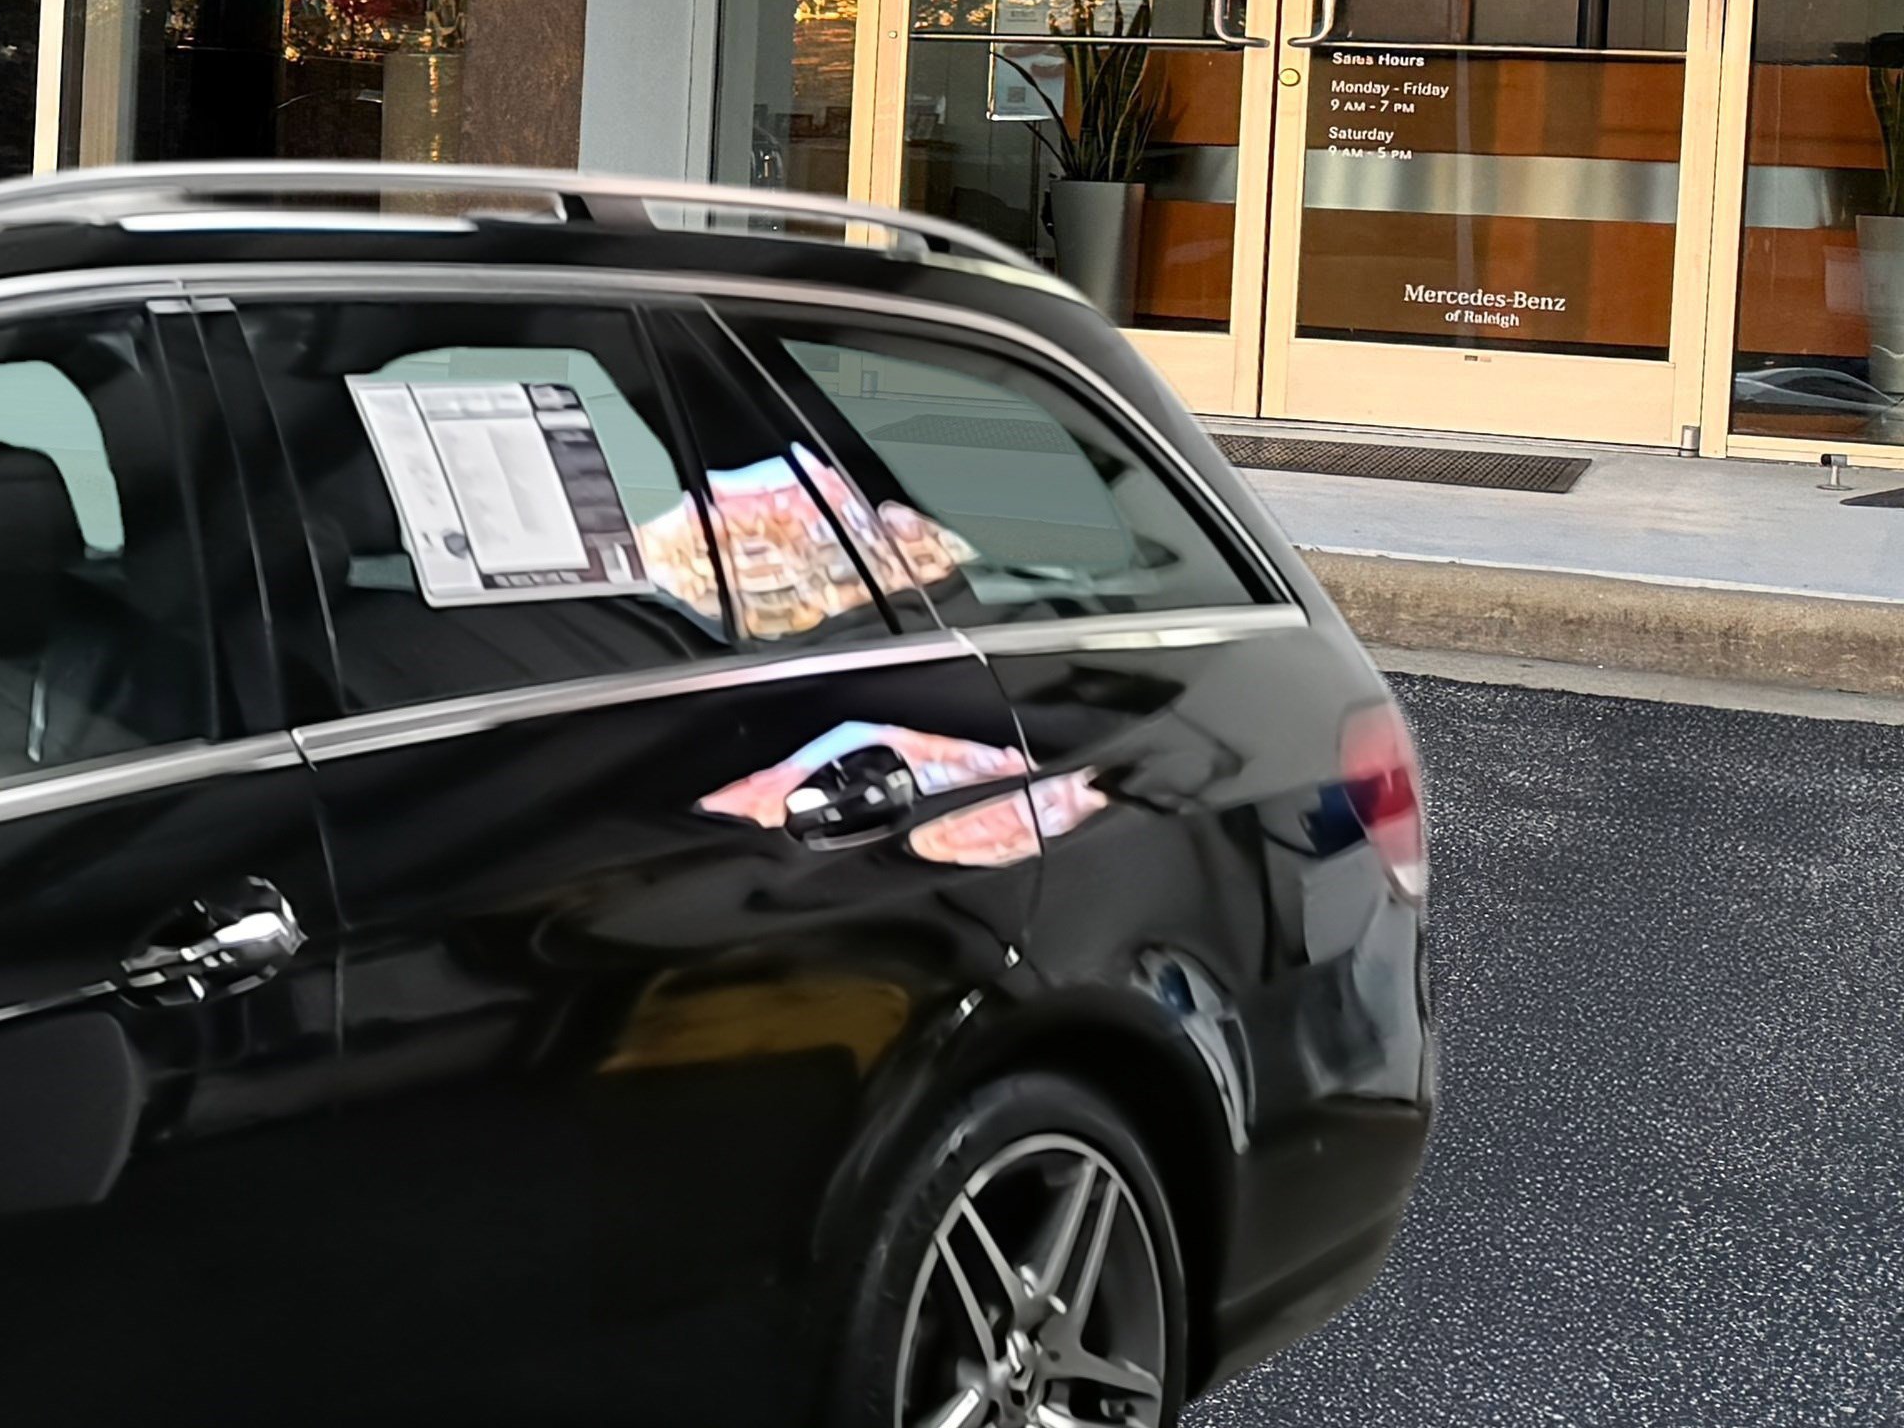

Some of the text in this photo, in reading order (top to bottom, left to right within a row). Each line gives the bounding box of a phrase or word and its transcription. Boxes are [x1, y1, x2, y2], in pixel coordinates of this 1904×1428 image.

[1378, 53, 1425, 67] Hours
[1331, 80, 1390, 97] Monday
[1403, 82, 1450, 98] Friday
[1330, 98, 1340, 111] 9
[1343, 101, 1366, 112] AM
[1379, 100, 1389, 112] 7
[1393, 103, 1415, 113] PM
[1328, 126, 1394, 144] Saturday
[1328, 145, 1337, 157] 9
[1342, 147, 1364, 158] AM
[1391, 149, 1413, 160] PM
[1403, 284, 1566, 312] Mercedes-Benz
[1444, 309, 1520, 328] of Raleigh
